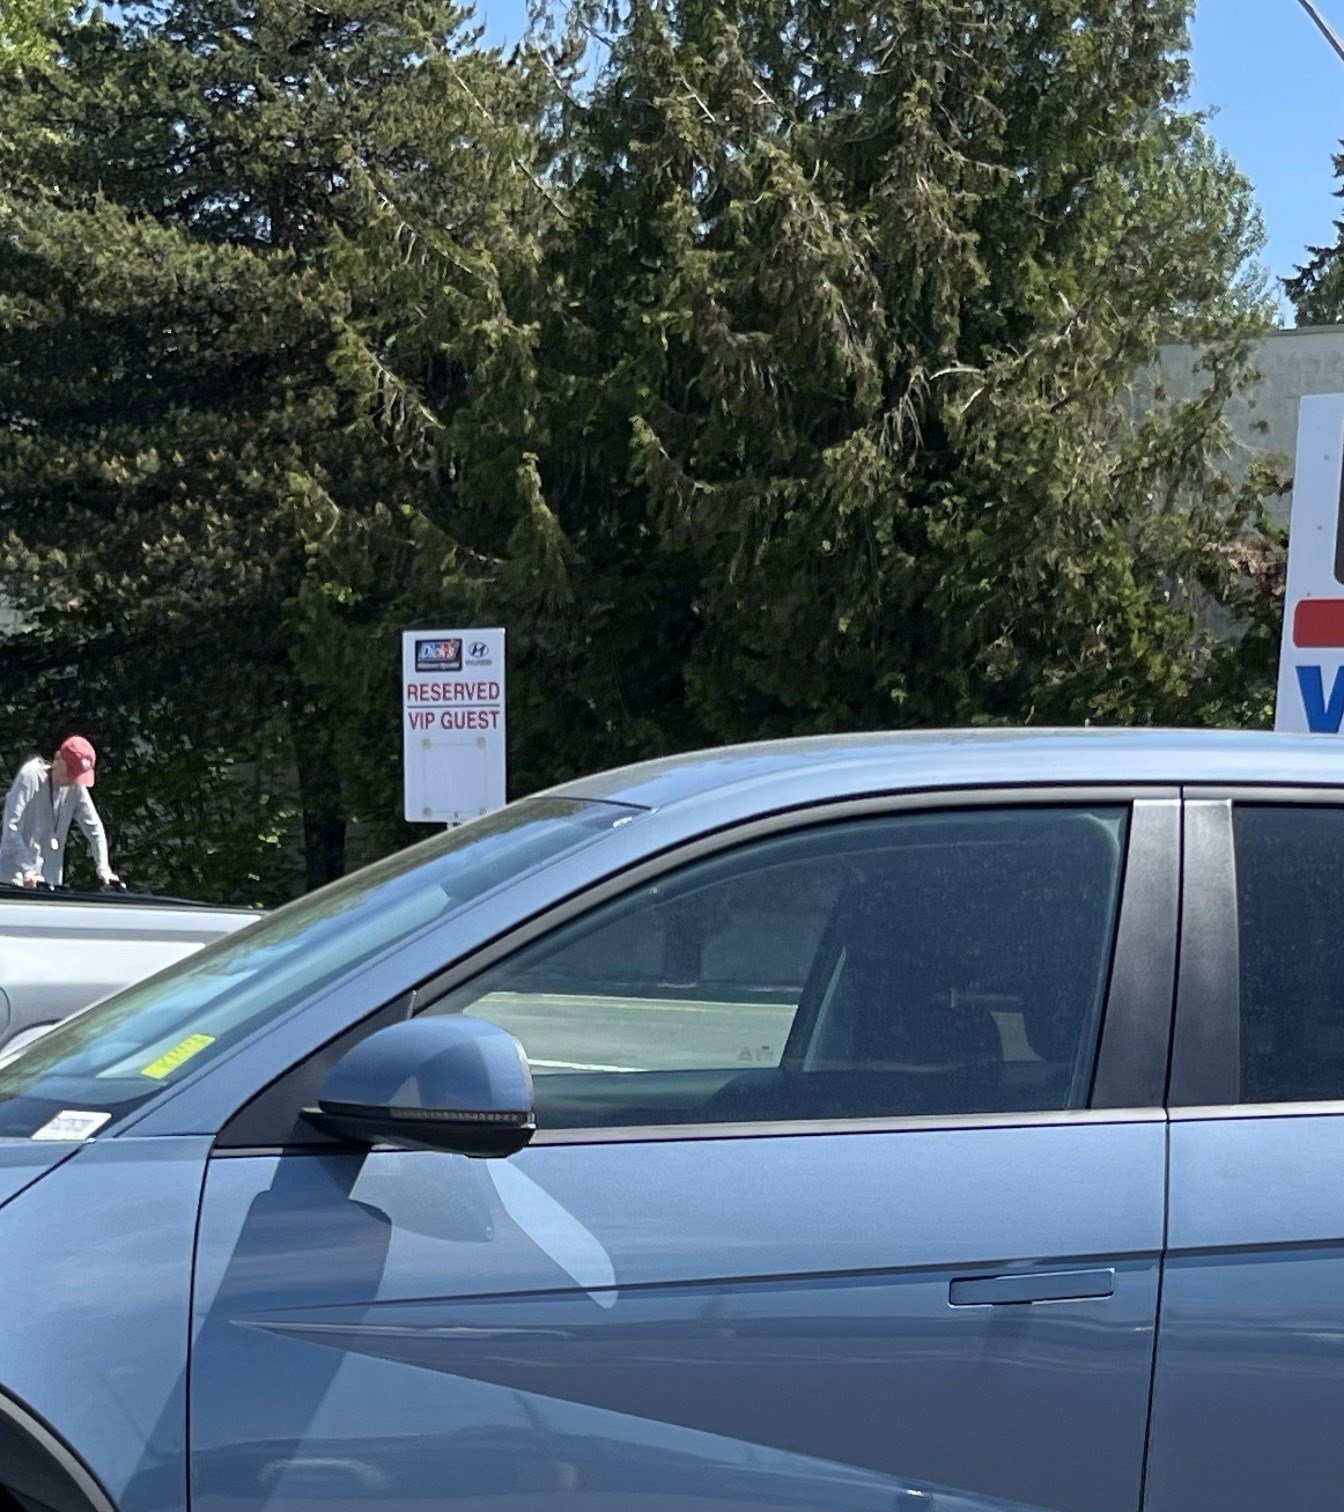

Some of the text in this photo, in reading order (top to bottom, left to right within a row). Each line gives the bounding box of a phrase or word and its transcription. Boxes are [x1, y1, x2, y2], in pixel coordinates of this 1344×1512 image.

[407, 682, 500, 701] RESERVED
[409, 711, 500, 730] VIP GUEST
